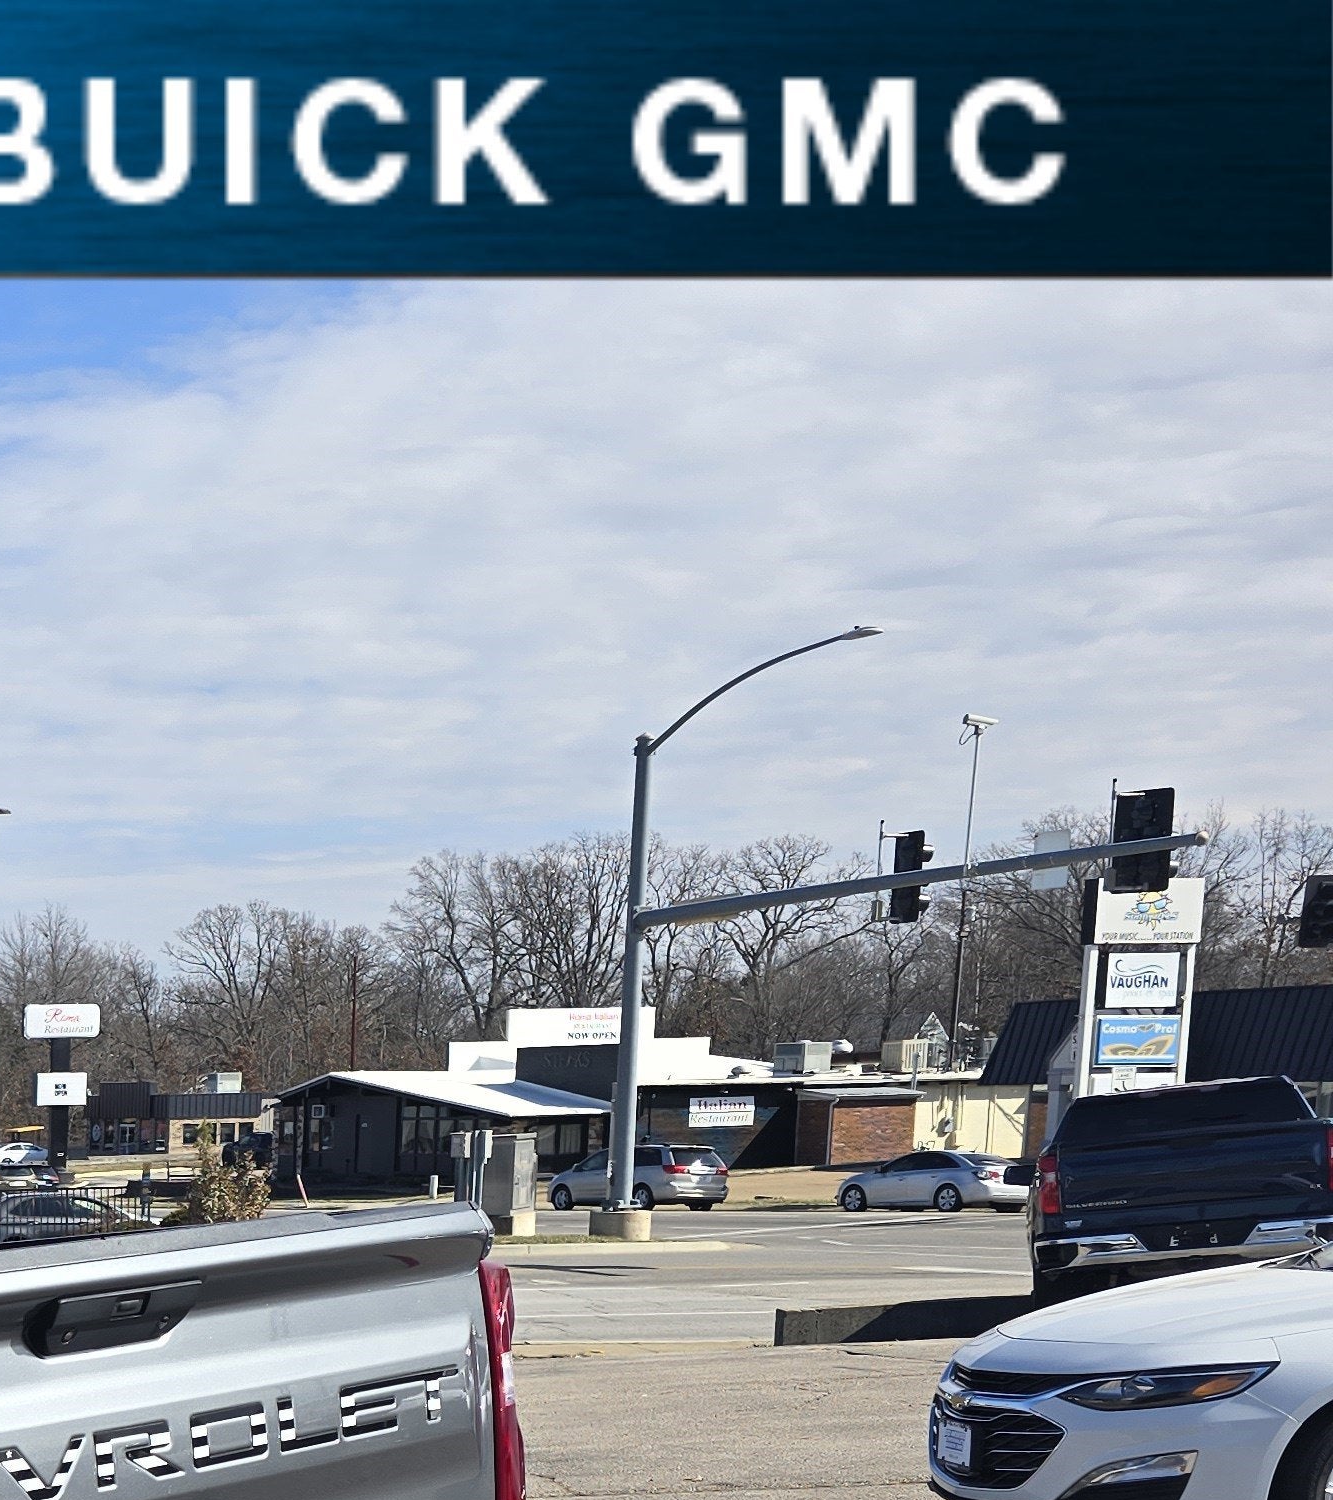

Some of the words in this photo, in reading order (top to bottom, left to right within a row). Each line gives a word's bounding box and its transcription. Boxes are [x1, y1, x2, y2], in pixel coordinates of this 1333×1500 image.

[1110, 976, 1169, 989] VAUGHAN
[1102, 1023, 1138, 1035] Cosmo
[568, 1032, 589, 1040] NOW
[593, 1032, 617, 1040] OPEN
